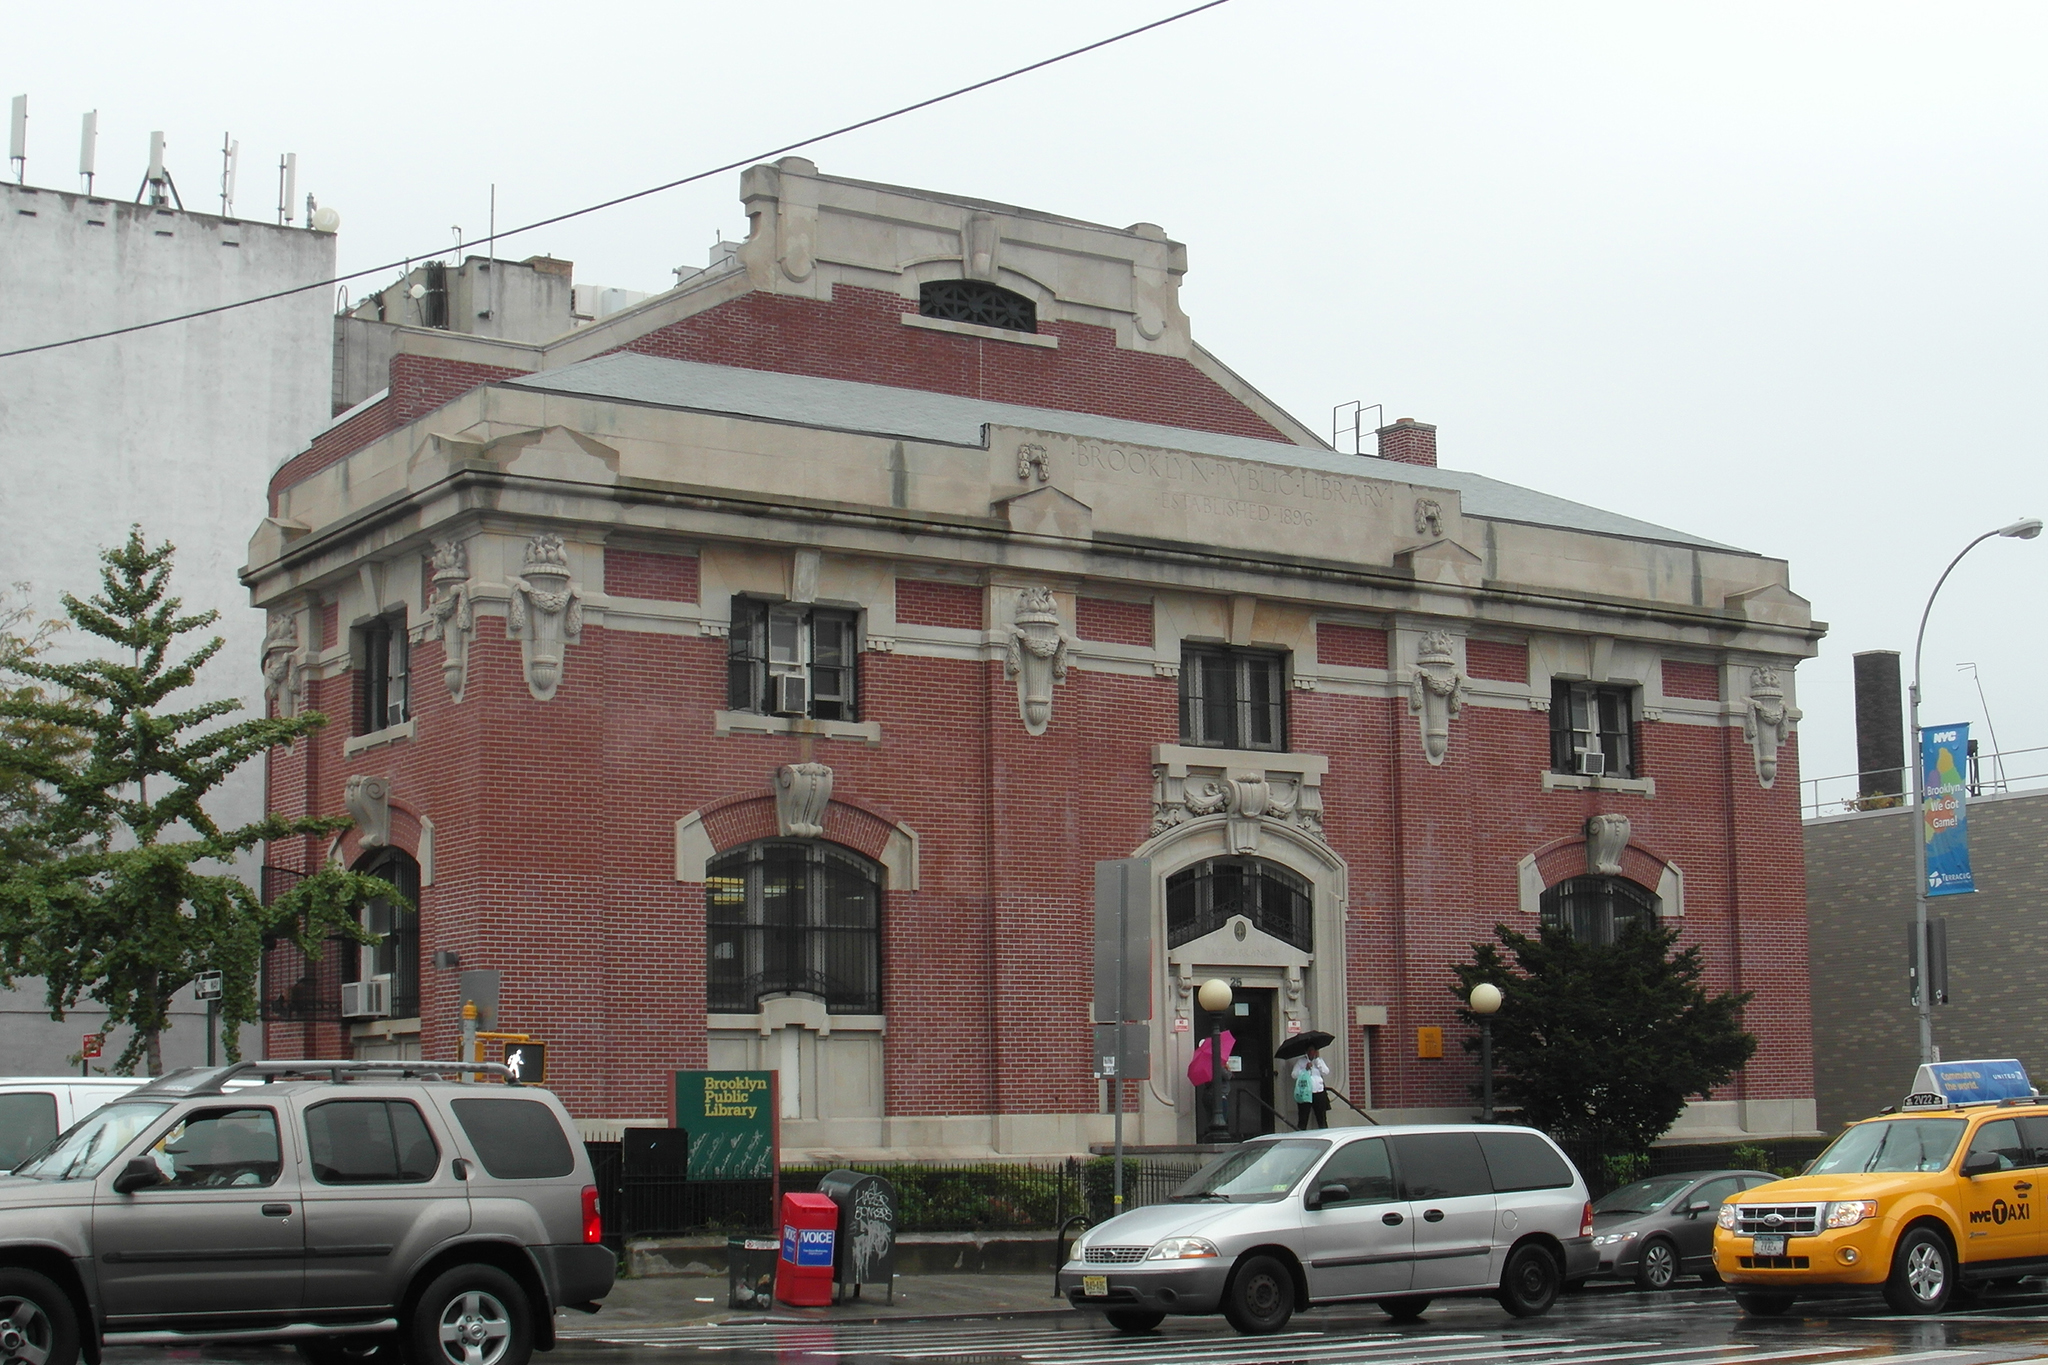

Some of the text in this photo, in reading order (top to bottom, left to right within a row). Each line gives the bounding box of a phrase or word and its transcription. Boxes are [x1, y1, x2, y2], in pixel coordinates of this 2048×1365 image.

[1076, 444, 1209, 484] BROOKLYN
[1301, 475, 1388, 508] LIBRARY
[1161, 491, 1313, 527] ESTABLISHED 1896
[1933, 731, 1957, 744] NYC
[1927, 782, 1963, 796] Brooklyn.
[1930, 799, 1960, 812] We Got
[1932, 815, 1958, 828] Game!
[1941, 1071, 1981, 1080] Commute to
[1992, 1072, 2016, 1080] UNITED
[704, 1076, 767, 1092] Brooklyn
[1945, 1081, 1979, 1091] the world.
[704, 1090, 749, 1103] Public
[1913, 1094, 1933, 1105] 2V22
[704, 1103, 757, 1119] Library
[1969, 1200, 2029, 1224] NYC TAXI
[802, 1231, 833, 1244] VOICE
